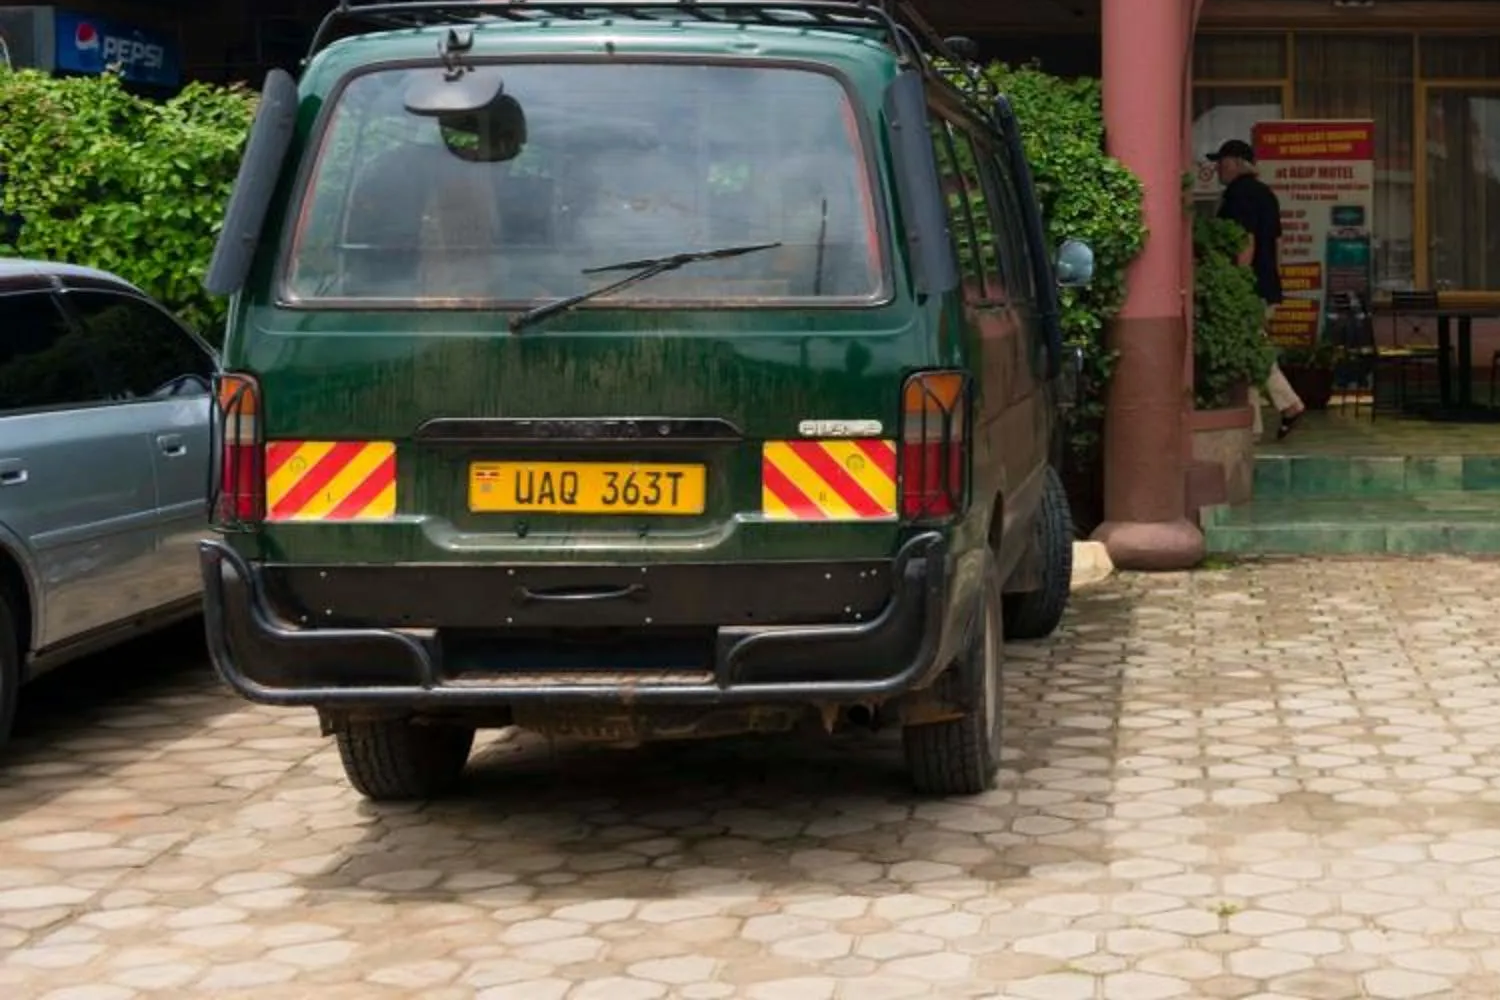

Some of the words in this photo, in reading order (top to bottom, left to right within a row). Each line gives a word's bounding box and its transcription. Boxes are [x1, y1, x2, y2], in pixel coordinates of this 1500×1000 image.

[103, 35, 164, 69] PEPSI
[514, 469, 579, 505] UAQ
[601, 471, 685, 506] 363T
